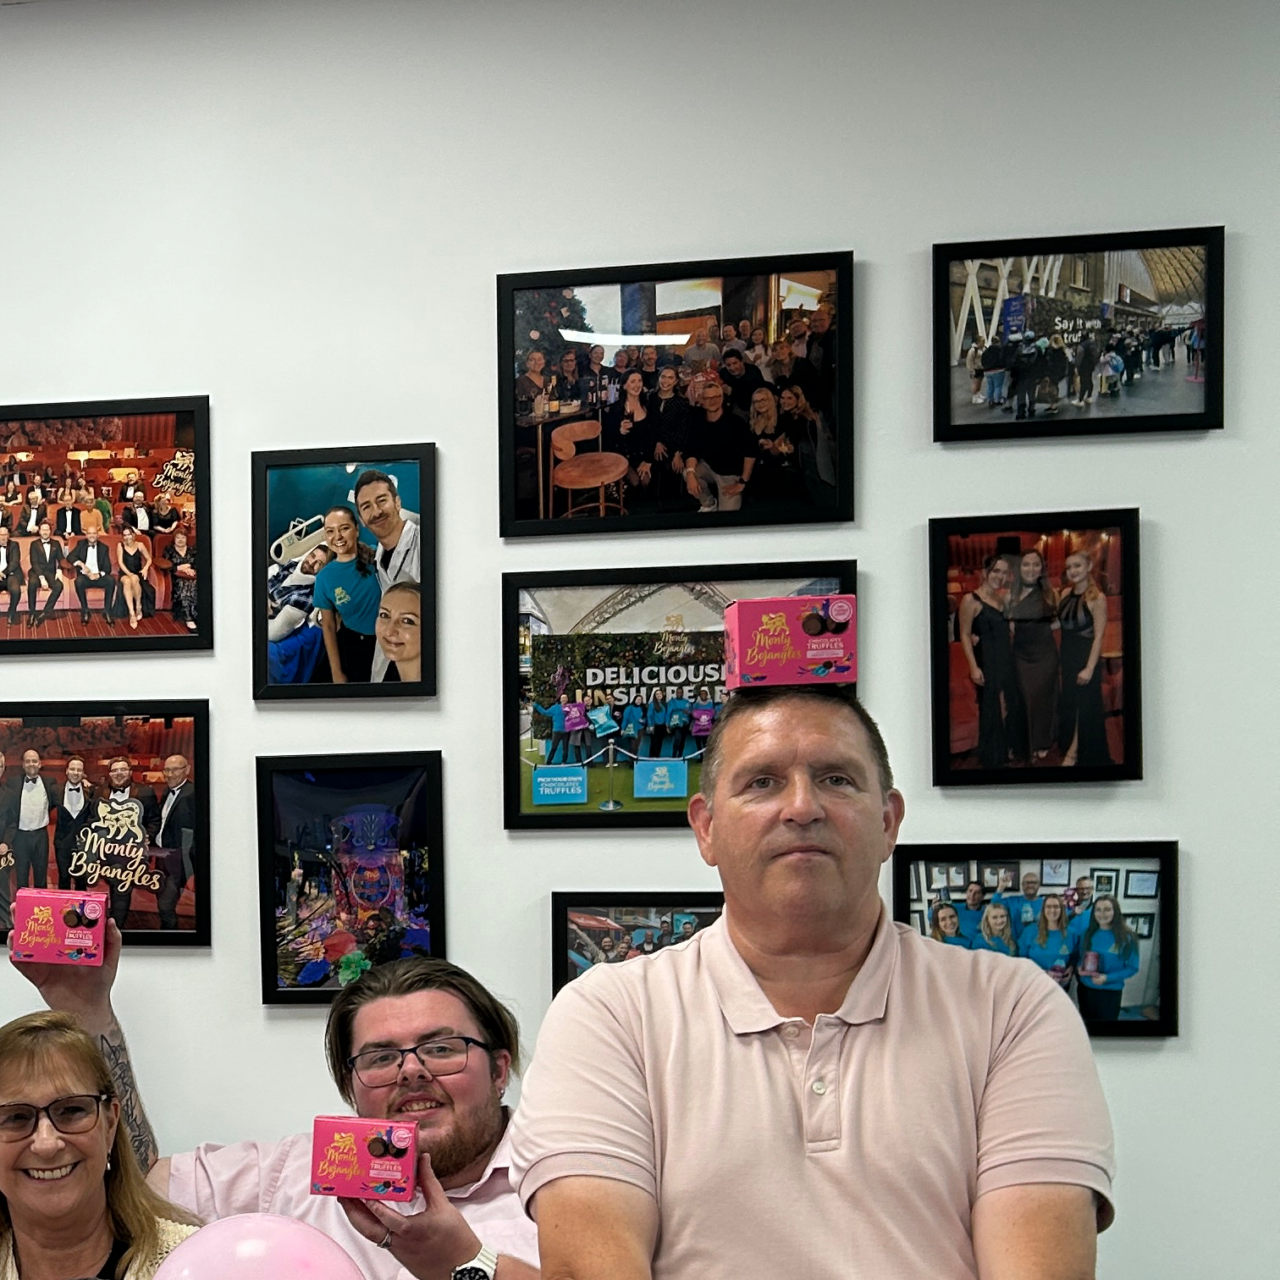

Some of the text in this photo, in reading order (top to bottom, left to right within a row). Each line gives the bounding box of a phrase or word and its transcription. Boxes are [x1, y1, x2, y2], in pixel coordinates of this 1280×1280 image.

[163, 462, 193, 484] Monty
[752, 631, 791, 650] Monty
[745, 647, 801, 667] Bojangles
[538, 786, 582, 795] TRUFFLES
[80, 827, 144, 870] Monty
[68, 852, 162, 892] Bojangles
[324, 1146, 357, 1165] Monty
